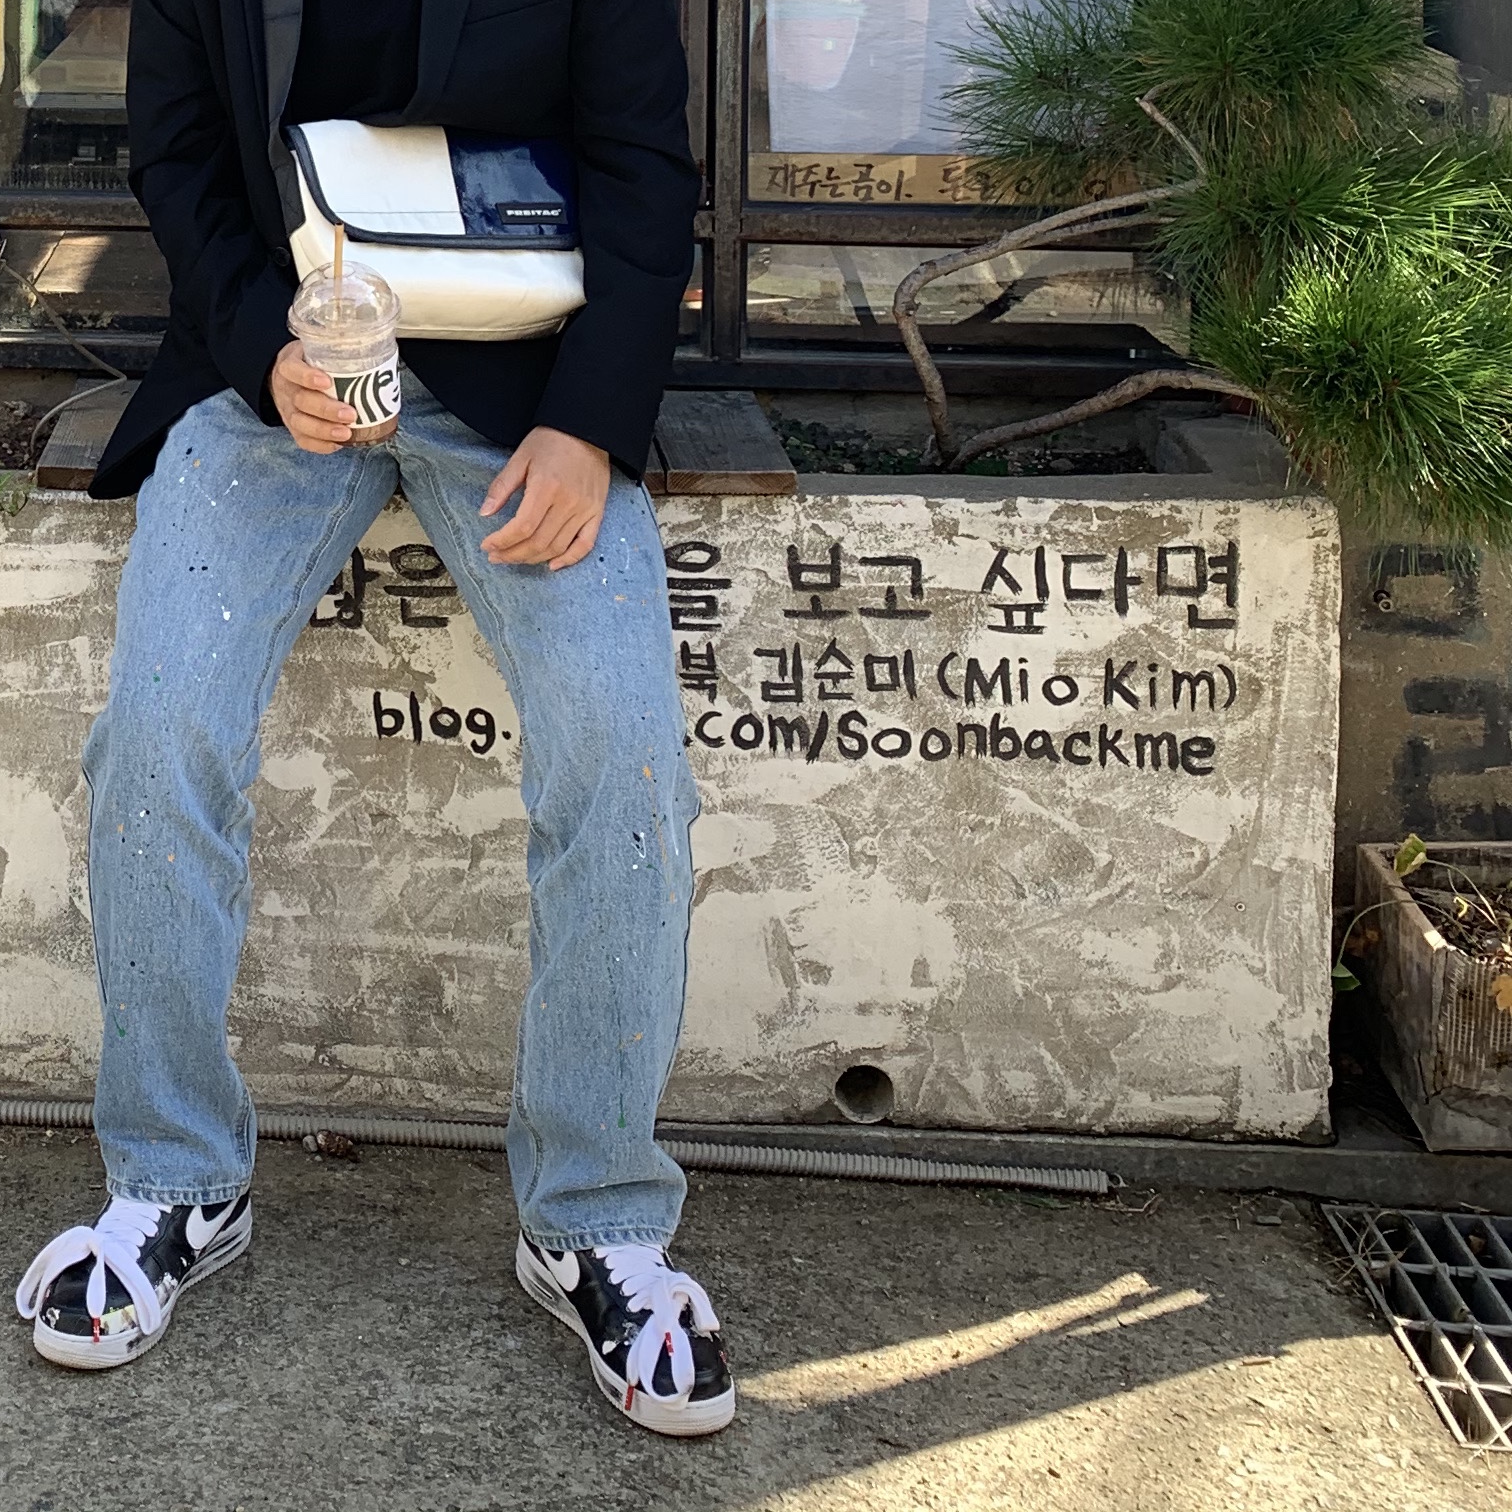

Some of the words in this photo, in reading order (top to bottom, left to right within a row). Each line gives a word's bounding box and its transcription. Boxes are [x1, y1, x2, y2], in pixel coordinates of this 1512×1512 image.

[783, 542, 932, 621] 보고
[979, 540, 1239, 635] 싶다면
[1103, 656, 1237, 712] Kim)
[373, 690, 513, 756] blog.
